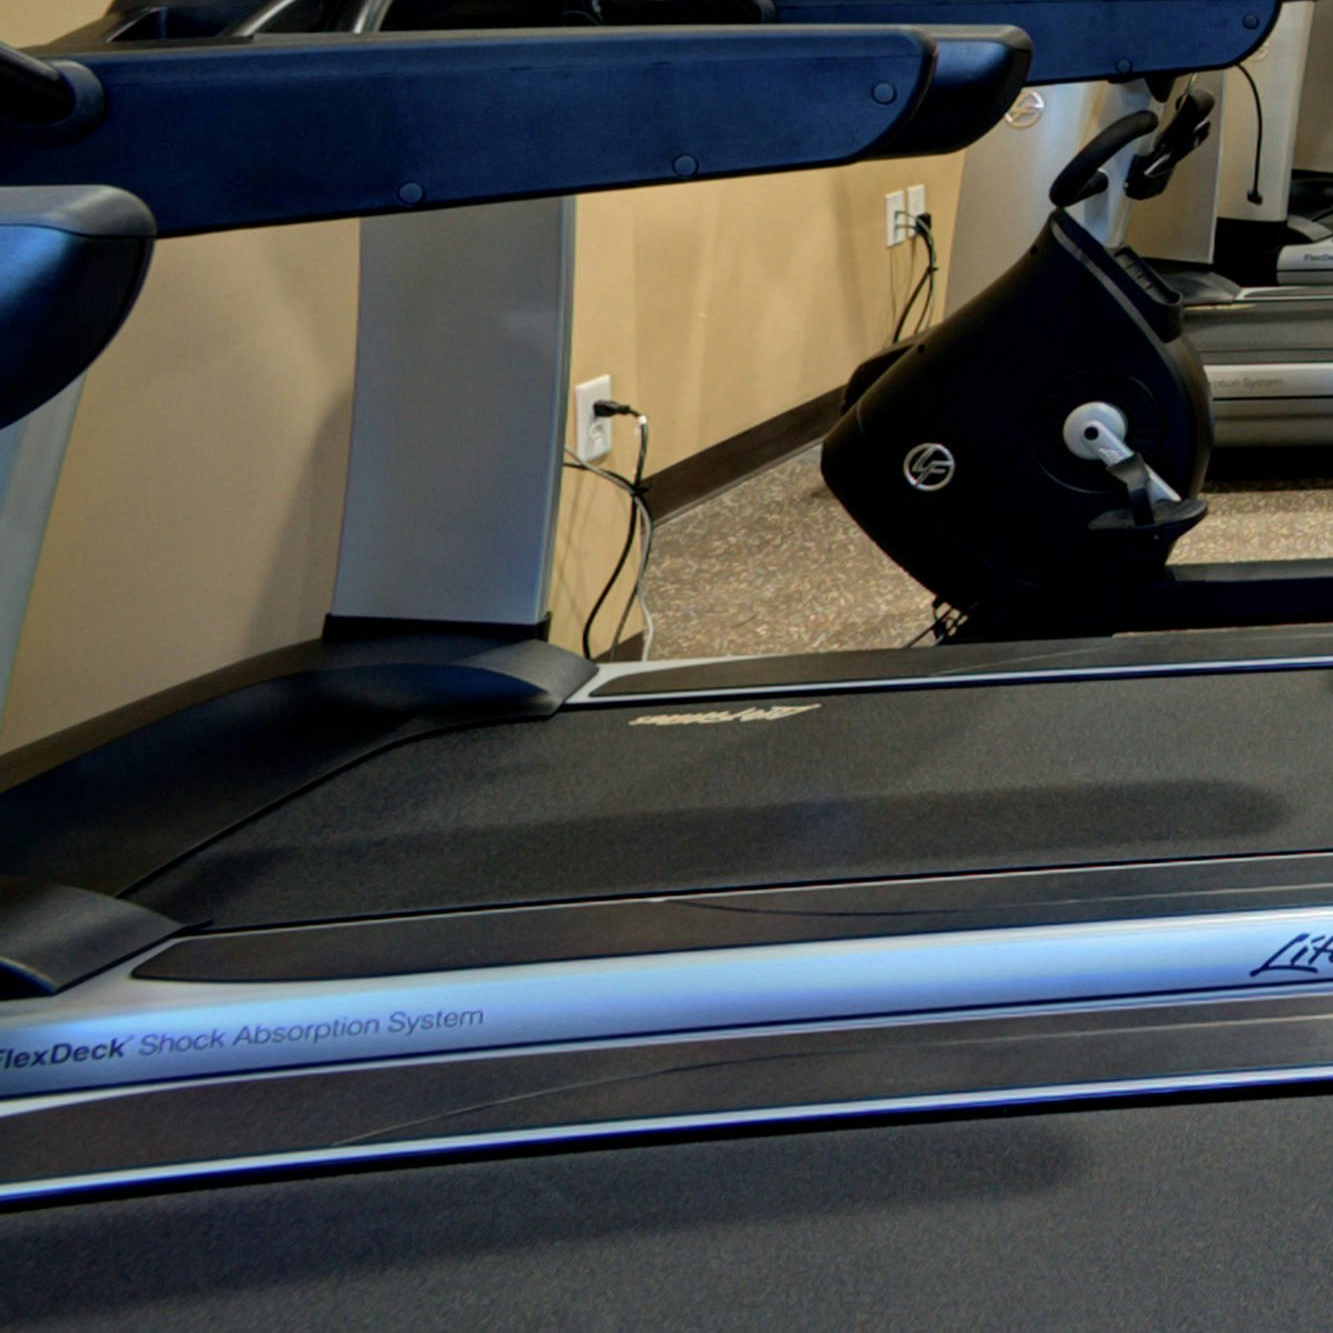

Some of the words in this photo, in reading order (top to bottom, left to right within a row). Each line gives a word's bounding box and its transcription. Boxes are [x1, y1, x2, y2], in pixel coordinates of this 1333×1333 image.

[139, 1028, 227, 1056] Shock
[232, 1017, 380, 1044] Absorption
[387, 1009, 484, 1036] System
